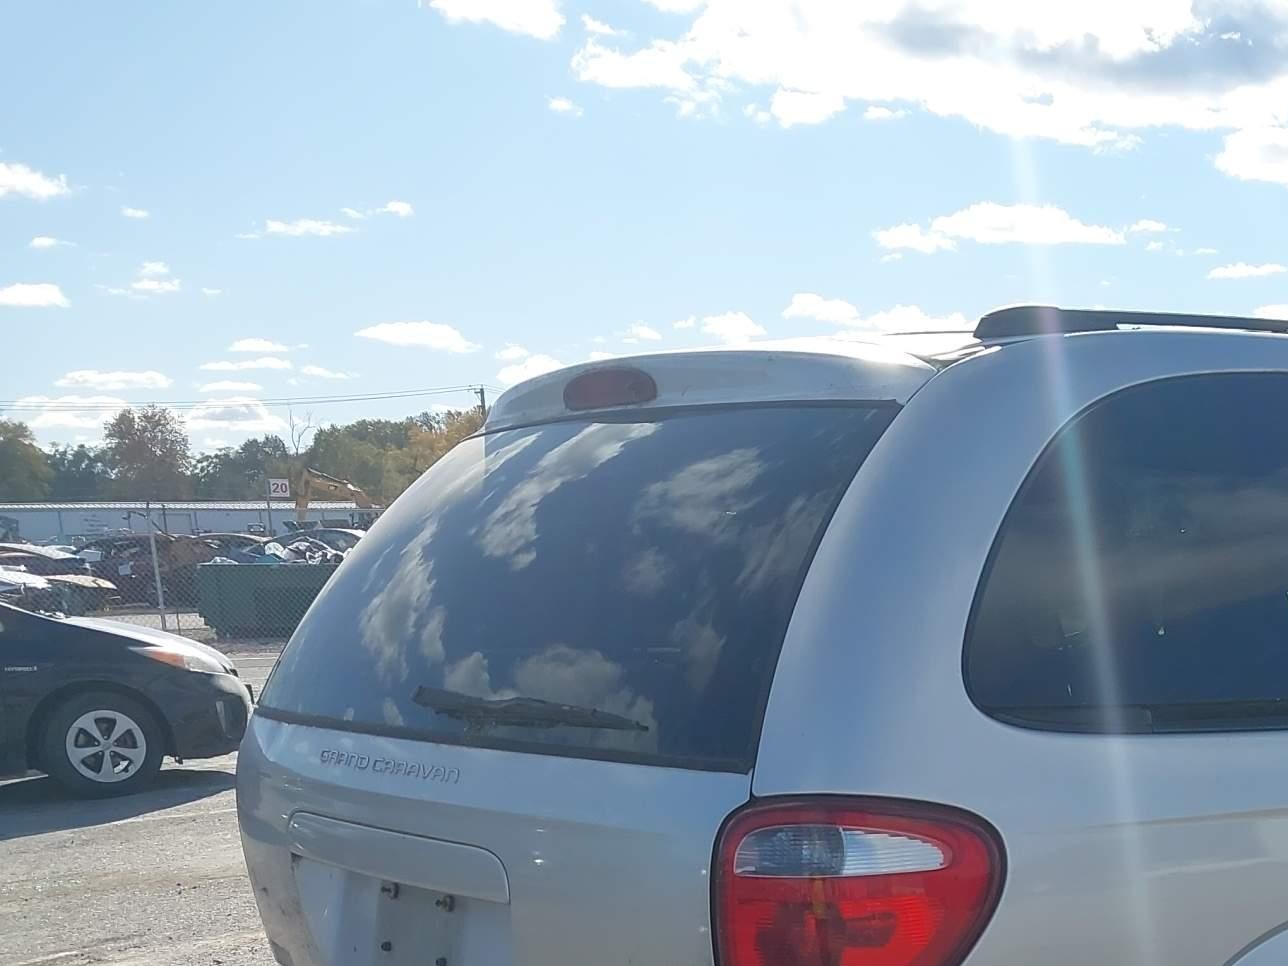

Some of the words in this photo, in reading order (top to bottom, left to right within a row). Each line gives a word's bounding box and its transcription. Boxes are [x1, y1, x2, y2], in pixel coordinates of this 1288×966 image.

[271, 482, 288, 493] 20
[320, 750, 370, 770] GRAND
[372, 757, 461, 784] CARAVAN
